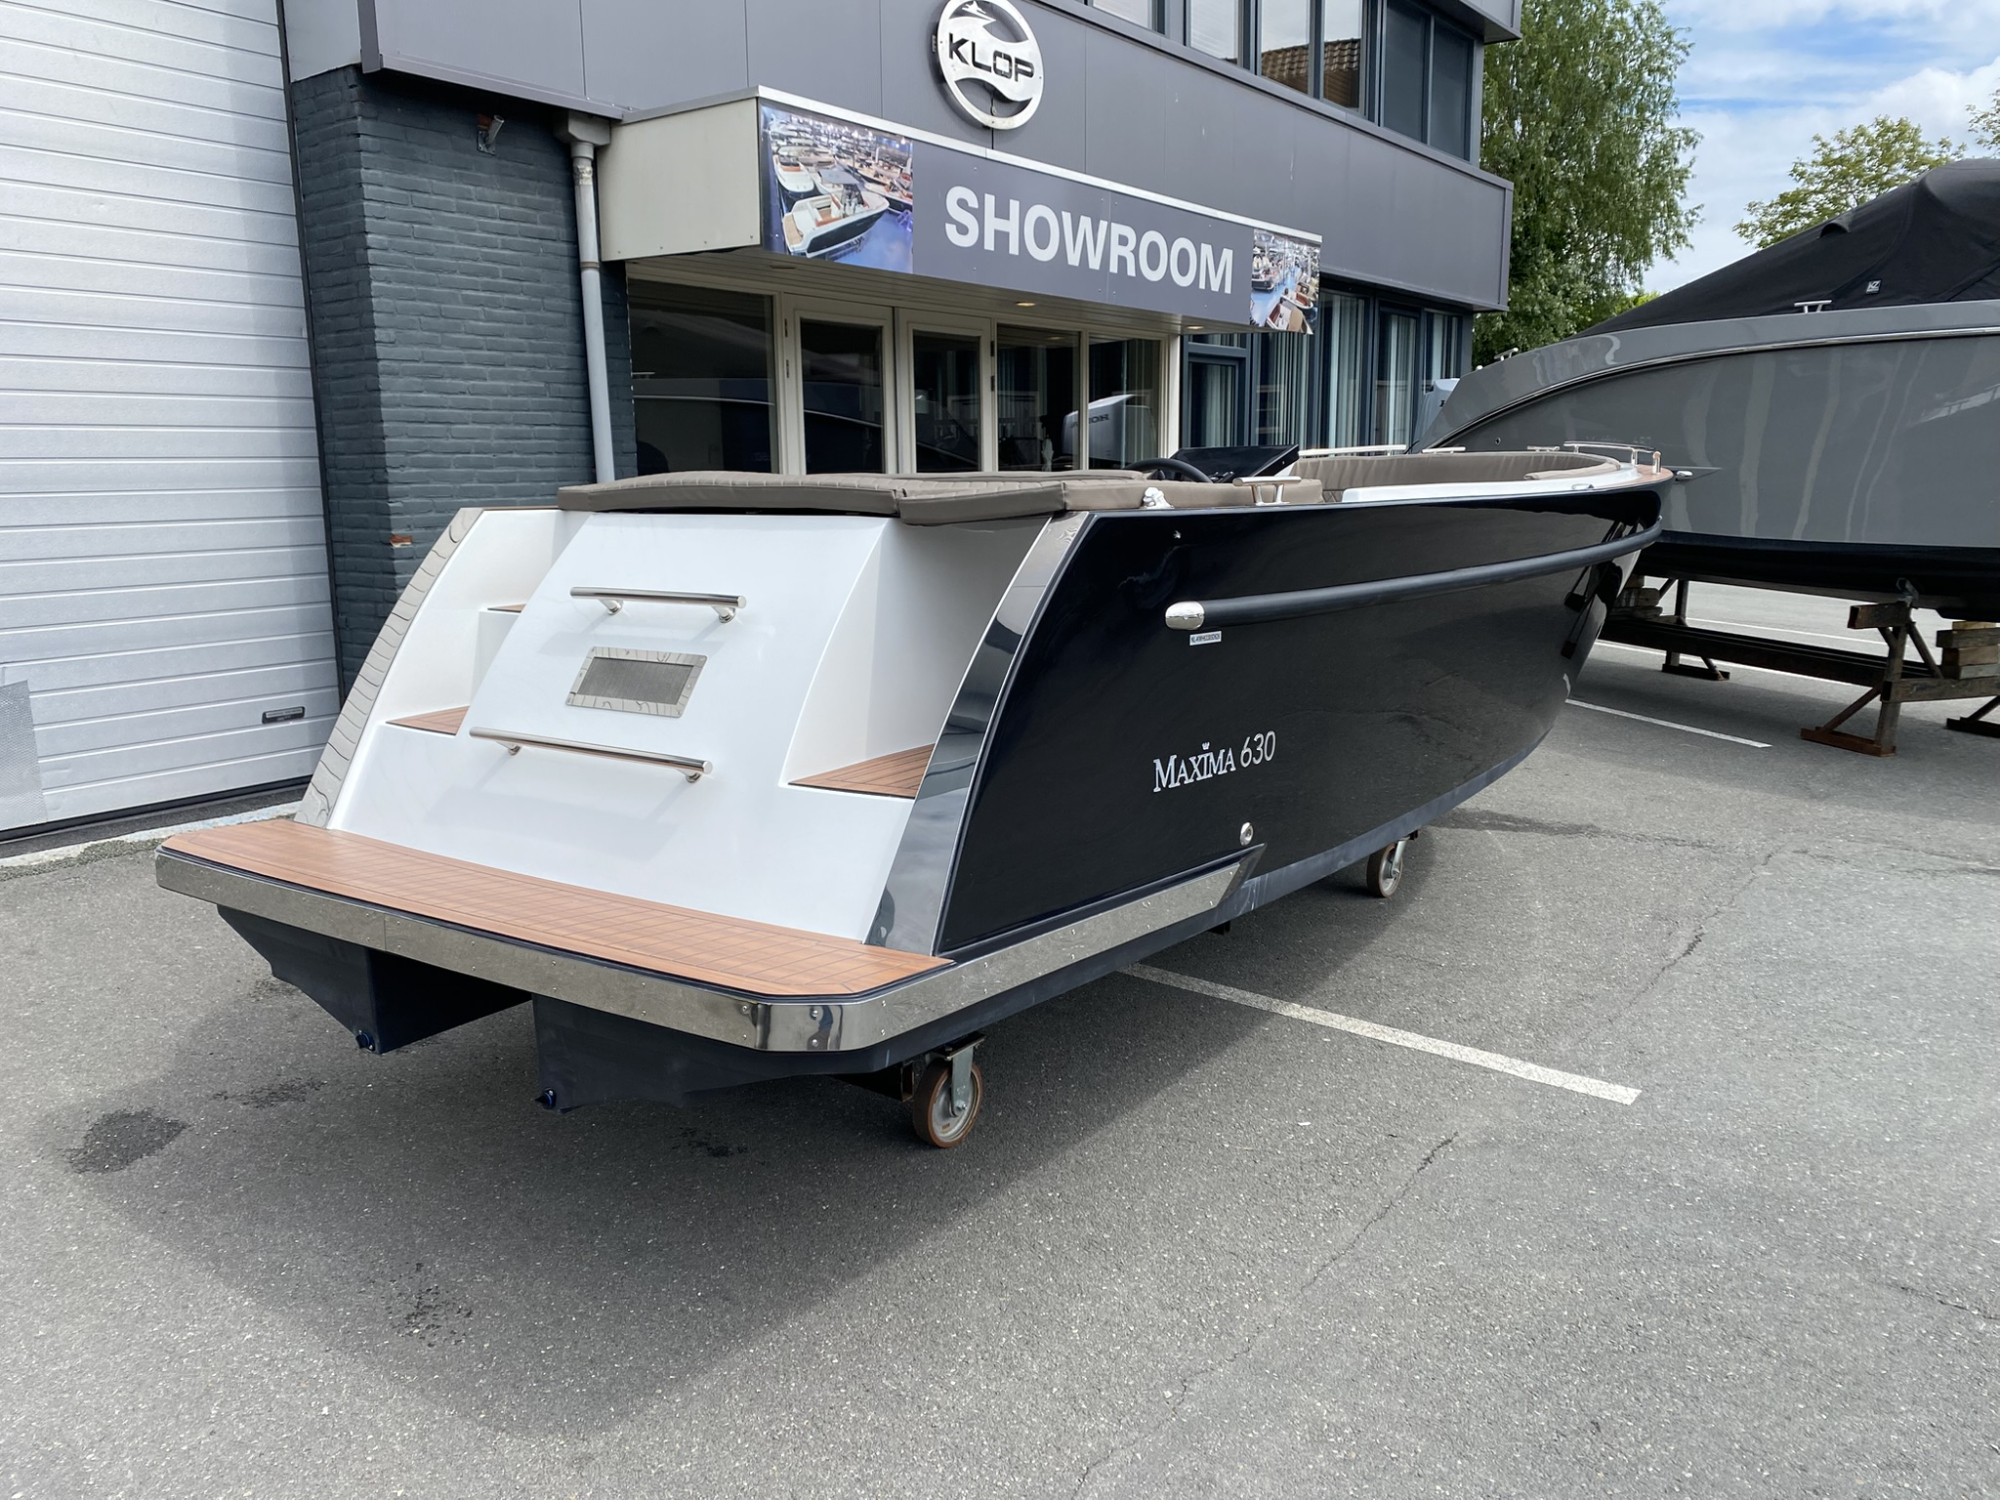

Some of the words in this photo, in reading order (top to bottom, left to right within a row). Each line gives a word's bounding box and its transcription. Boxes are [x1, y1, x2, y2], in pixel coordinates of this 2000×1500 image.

[949, 32, 1034, 82] KLOP
[945, 185, 1234, 294] SHOWROOM
[1240, 730, 1276, 768] 630
